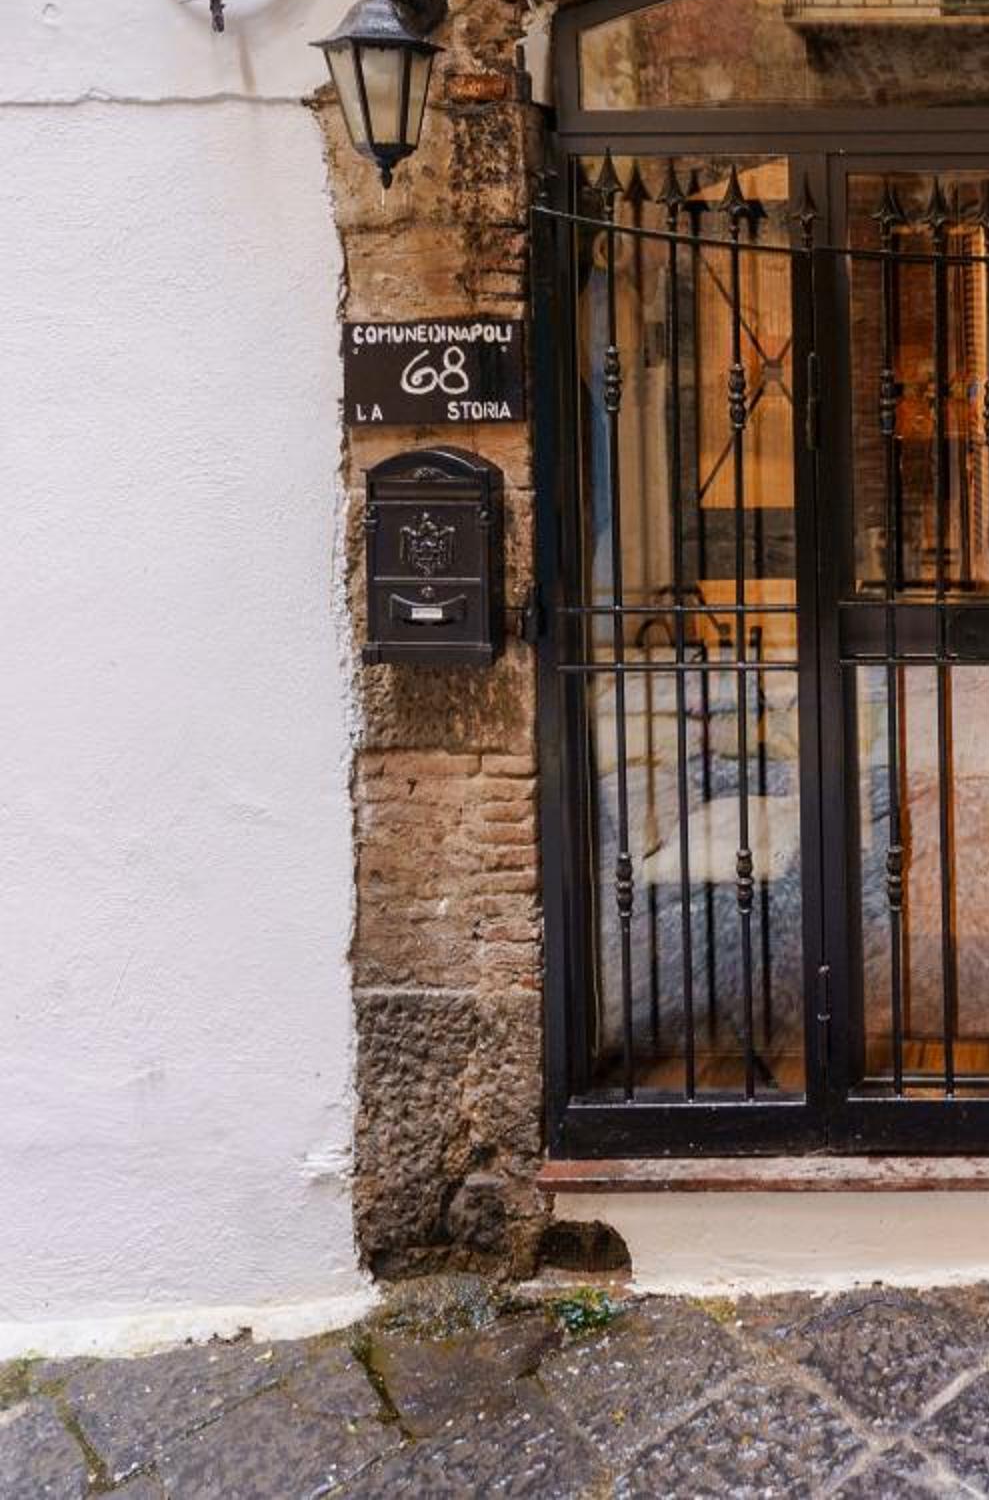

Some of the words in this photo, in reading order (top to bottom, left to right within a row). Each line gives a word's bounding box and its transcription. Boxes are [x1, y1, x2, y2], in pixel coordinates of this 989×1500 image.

[401, 346, 469, 395] 68
[355, 403, 384, 421] LA
[447, 401, 512, 420] STORIA
